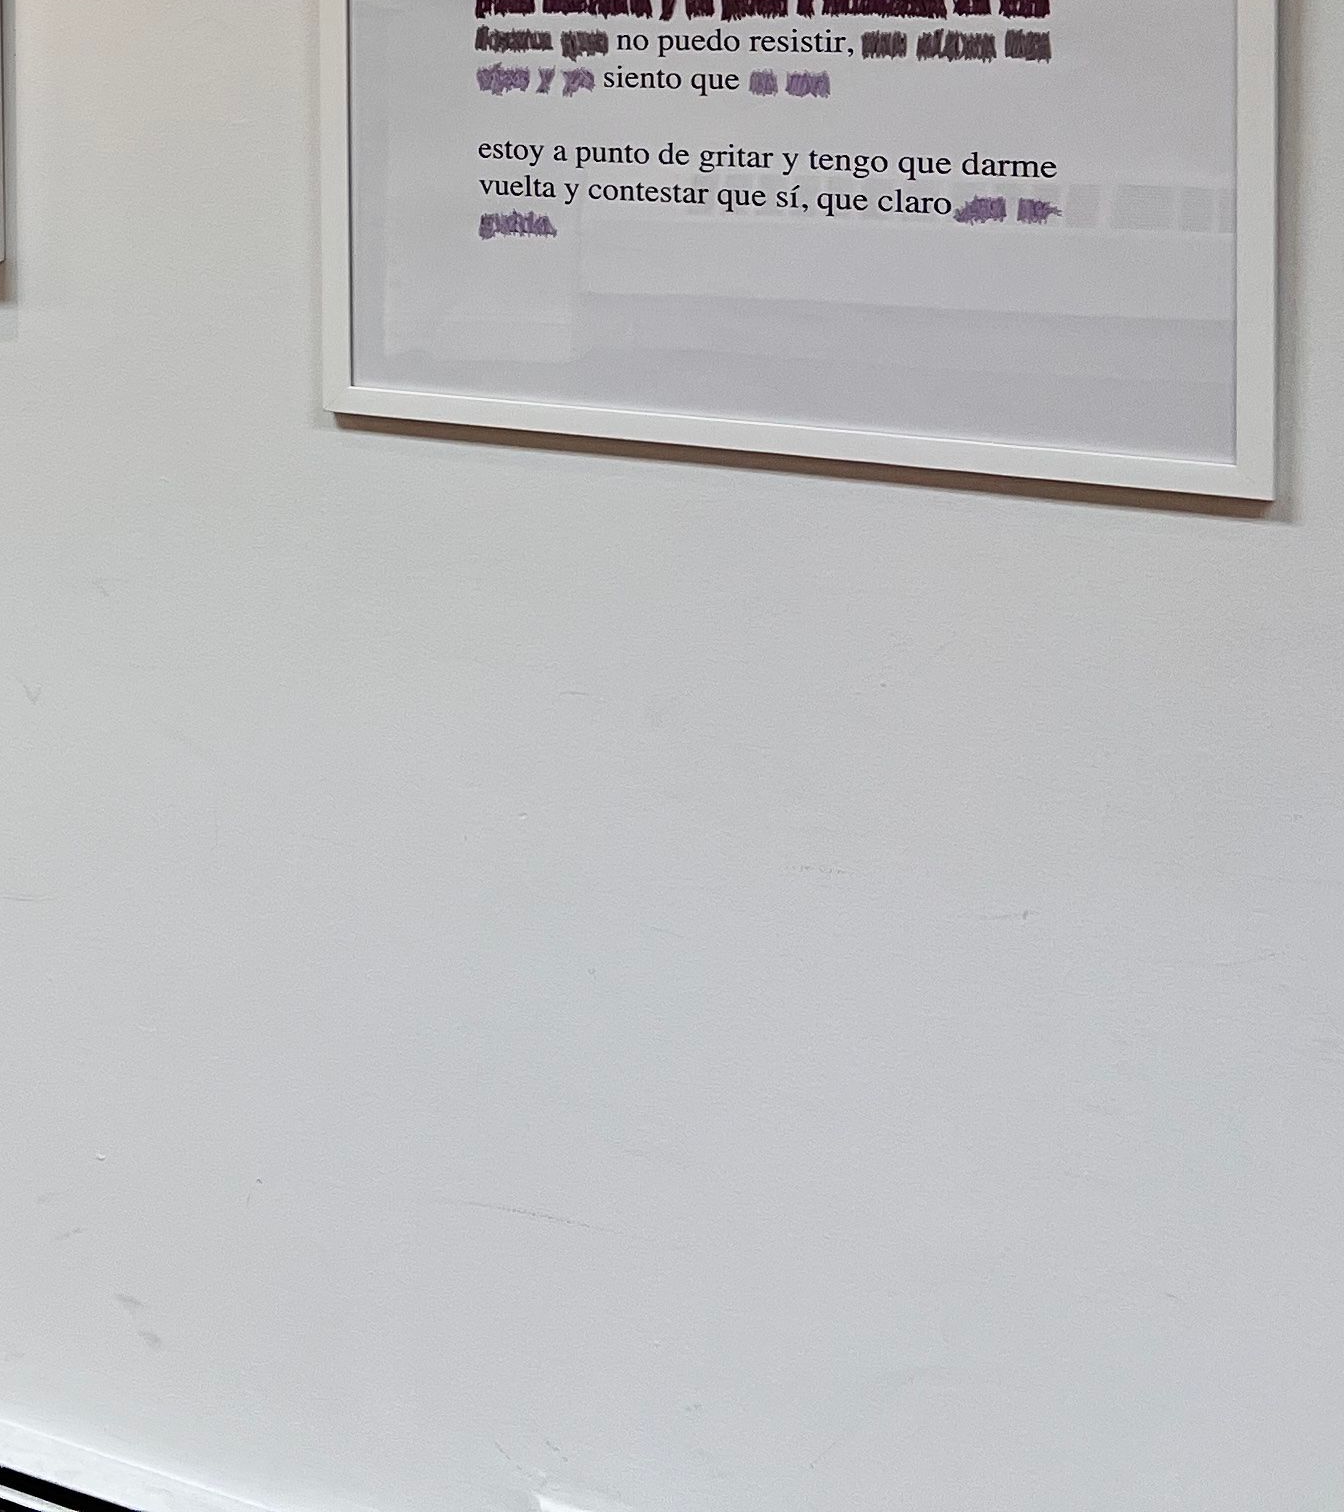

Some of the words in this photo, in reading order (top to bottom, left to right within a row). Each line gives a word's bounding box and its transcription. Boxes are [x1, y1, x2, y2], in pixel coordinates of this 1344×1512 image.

[616, 34, 649, 51] no
[657, 28, 741, 58] puedo
[748, 28, 854, 58] resistir,
[603, 65, 682, 90] siento
[690, 73, 740, 97] que
[478, 140, 545, 167] estoy
[553, 145, 568, 162] a
[575, 144, 650, 169] punto
[658, 142, 690, 166] de
[698, 143, 774, 173] gritar
[781, 152, 799, 176] y
[808, 149, 889, 179] tengo
[897, 156, 952, 181] que
[961, 151, 1058, 179] darme
[478, 174, 557, 198] vuelta
[563, 182, 580, 205] y
[588, 182, 710, 205] contestar
[717, 188, 767, 213] que
[775, 184, 809, 213] sí,
[816, 192, 869, 217] que
[877, 188, 952, 215] claro
